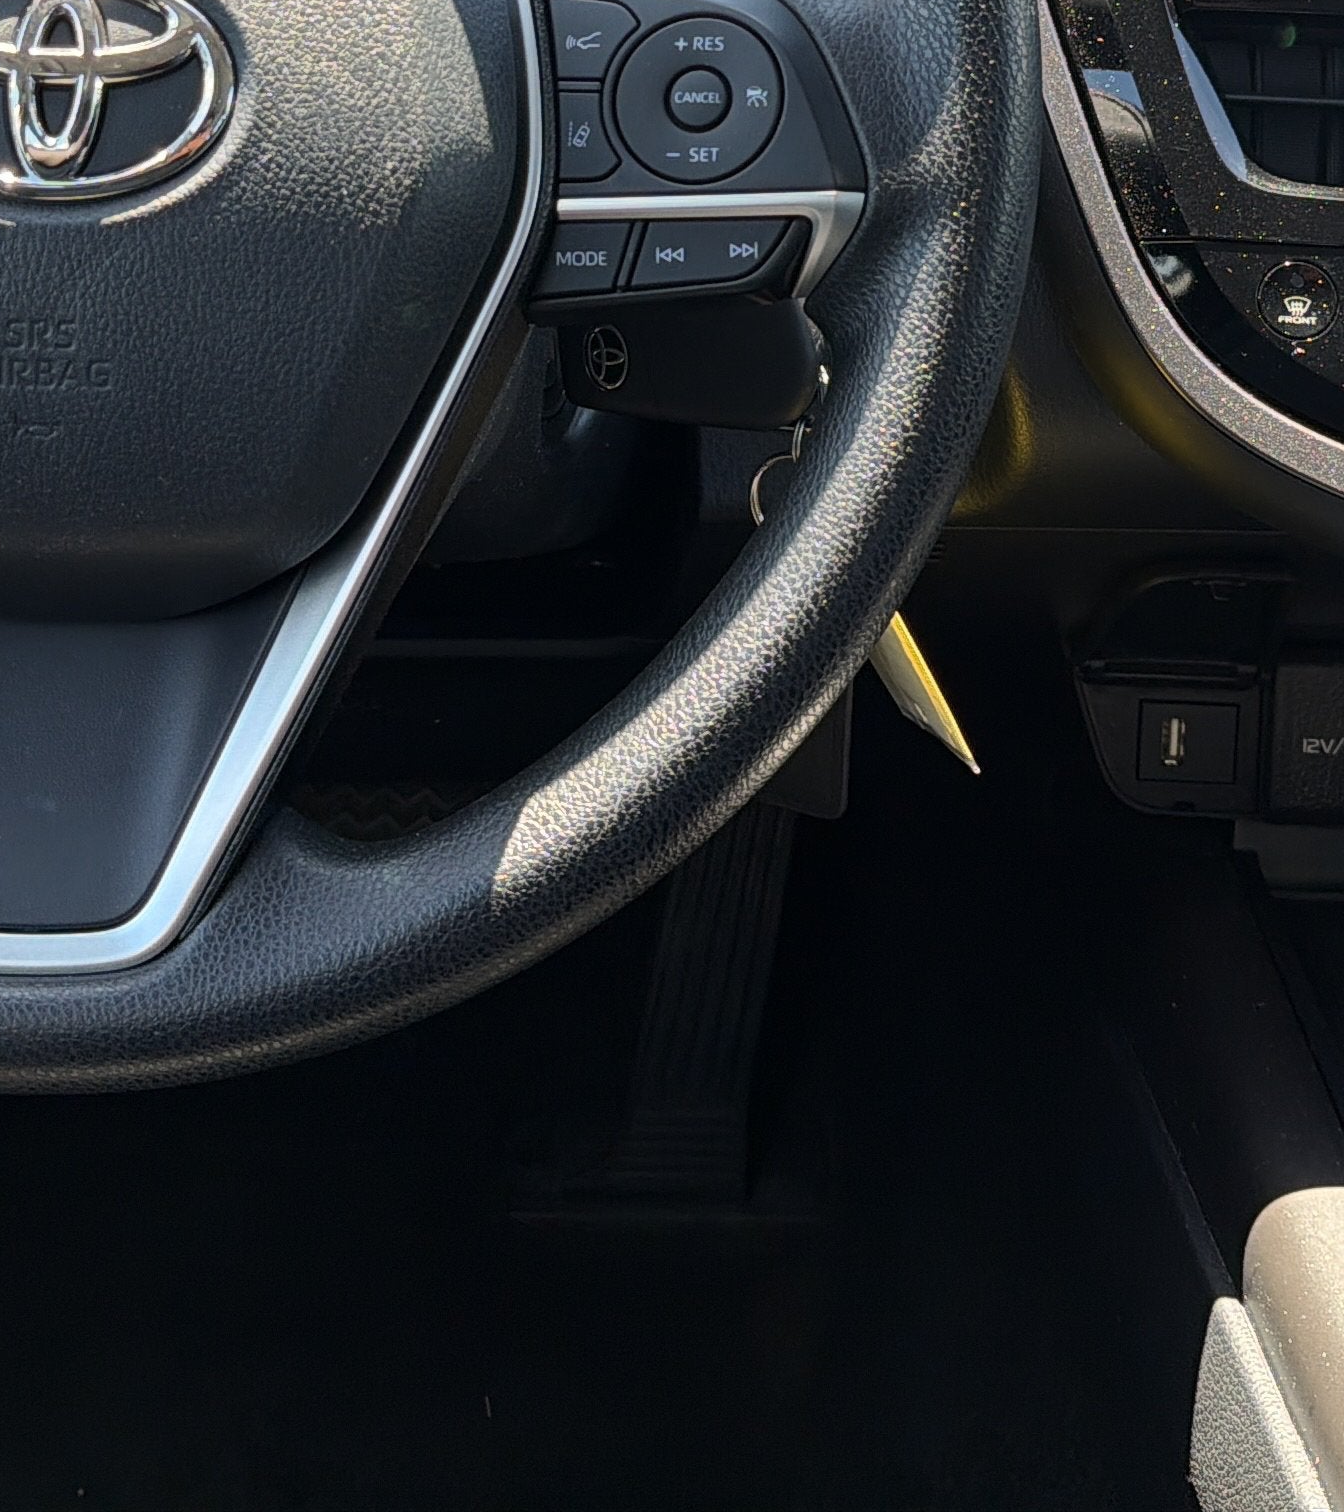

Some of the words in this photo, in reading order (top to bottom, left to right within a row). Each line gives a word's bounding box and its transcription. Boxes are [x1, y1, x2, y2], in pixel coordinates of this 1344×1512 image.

[693, 36, 725, 52] RES
[674, 90, 722, 105] CANCEL
[688, 147, 719, 163] SET
[556, 250, 608, 268] MODE
[1277, 314, 1318, 327] FRONT
